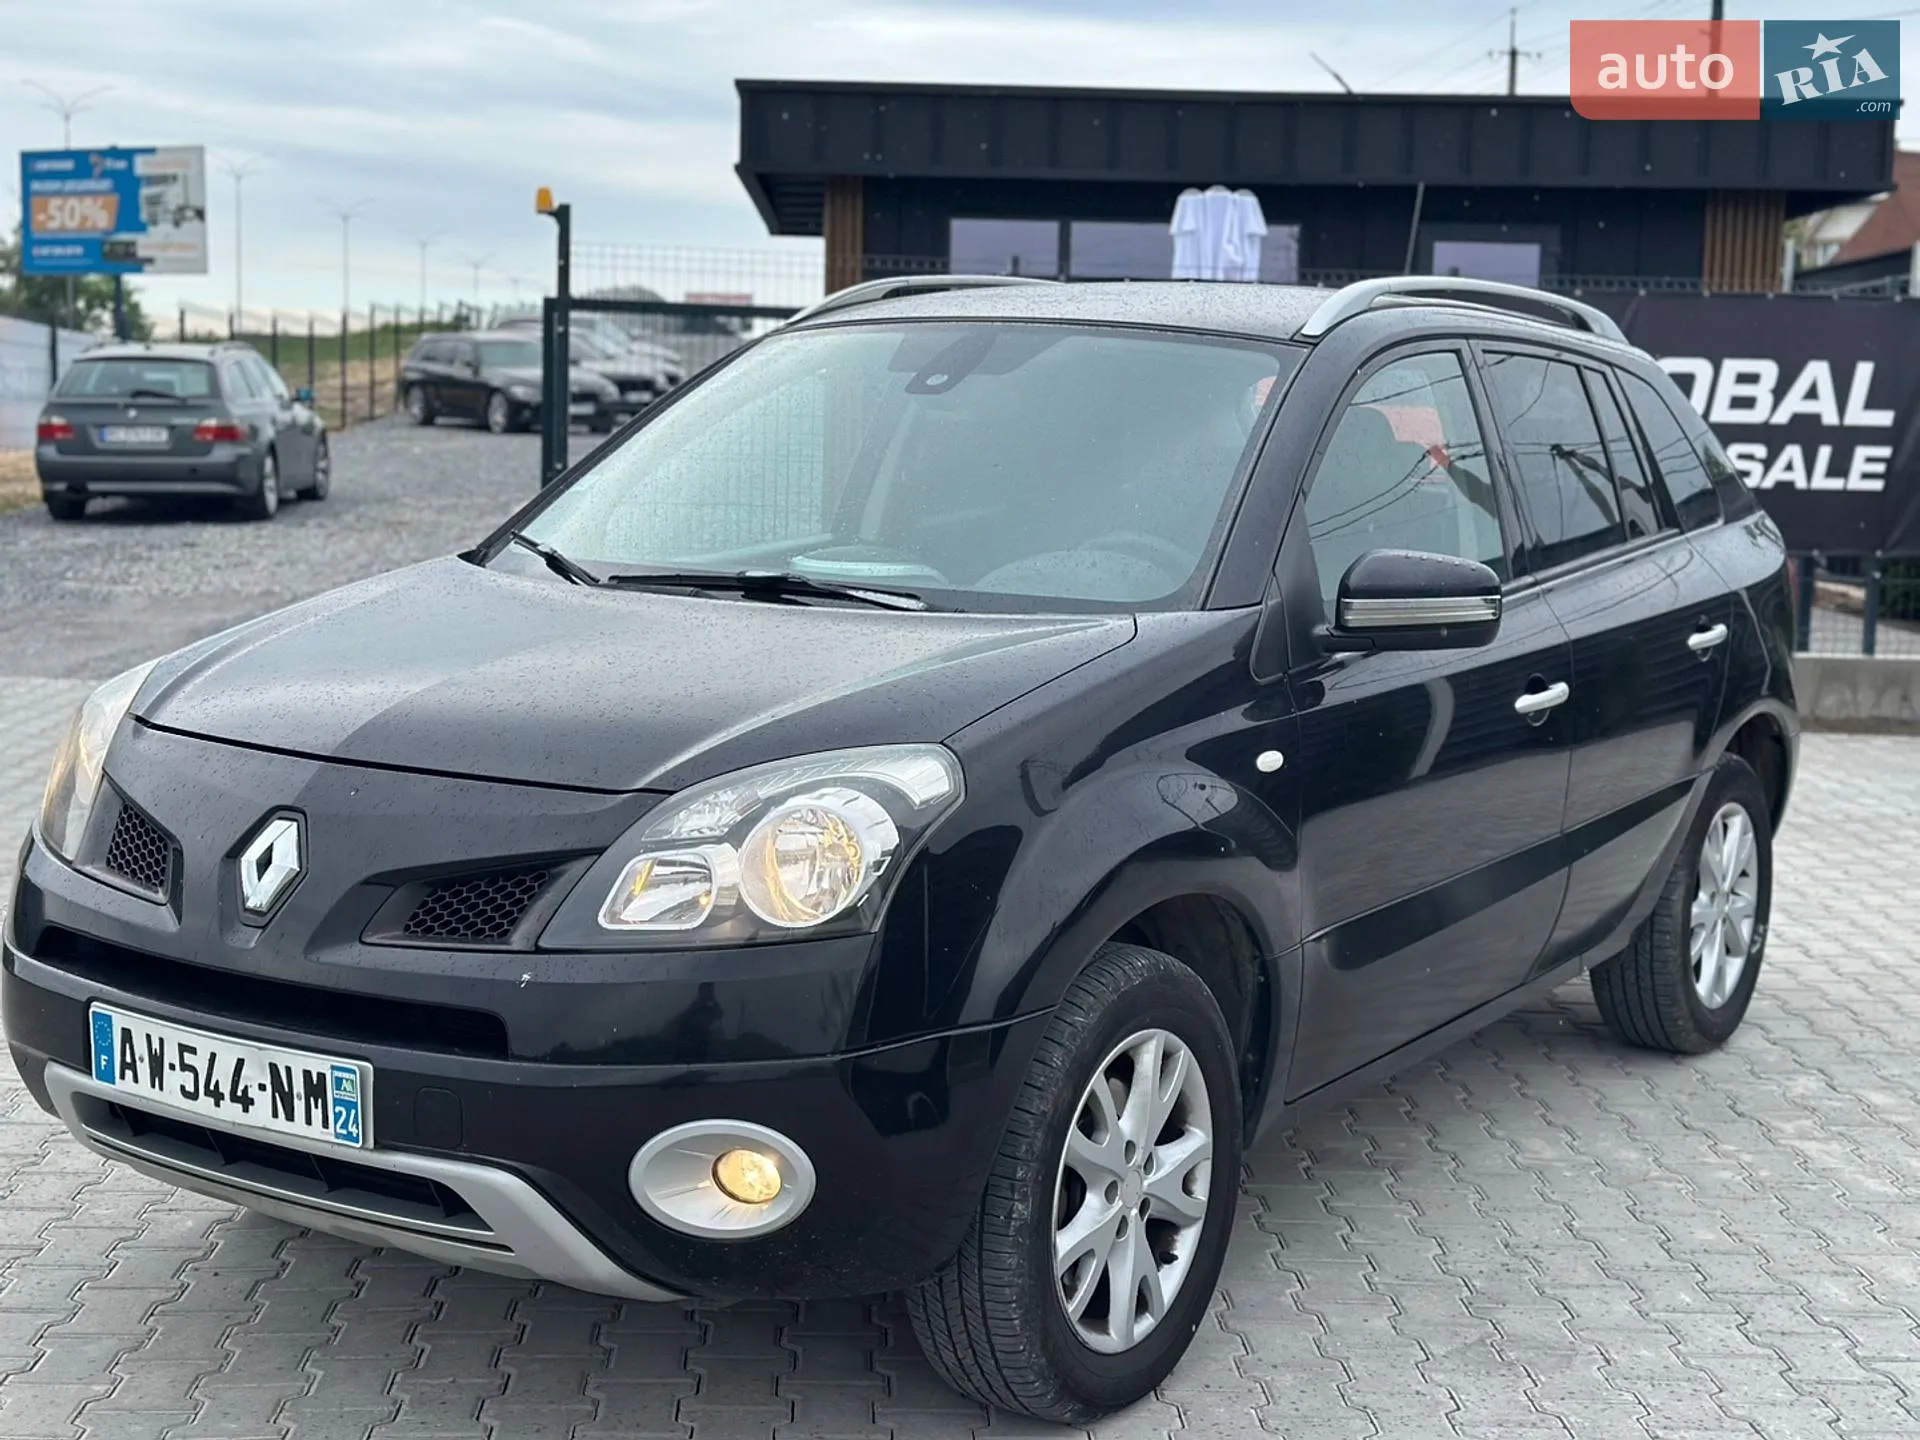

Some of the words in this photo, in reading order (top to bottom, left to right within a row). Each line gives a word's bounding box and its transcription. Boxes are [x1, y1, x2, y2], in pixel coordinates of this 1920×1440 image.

[36, 198, 109, 230] -50%
[100, 1054, 109, 1071] F
[119, 1027, 330, 1130] AW-544-NM
[335, 1105, 360, 1137] 24
